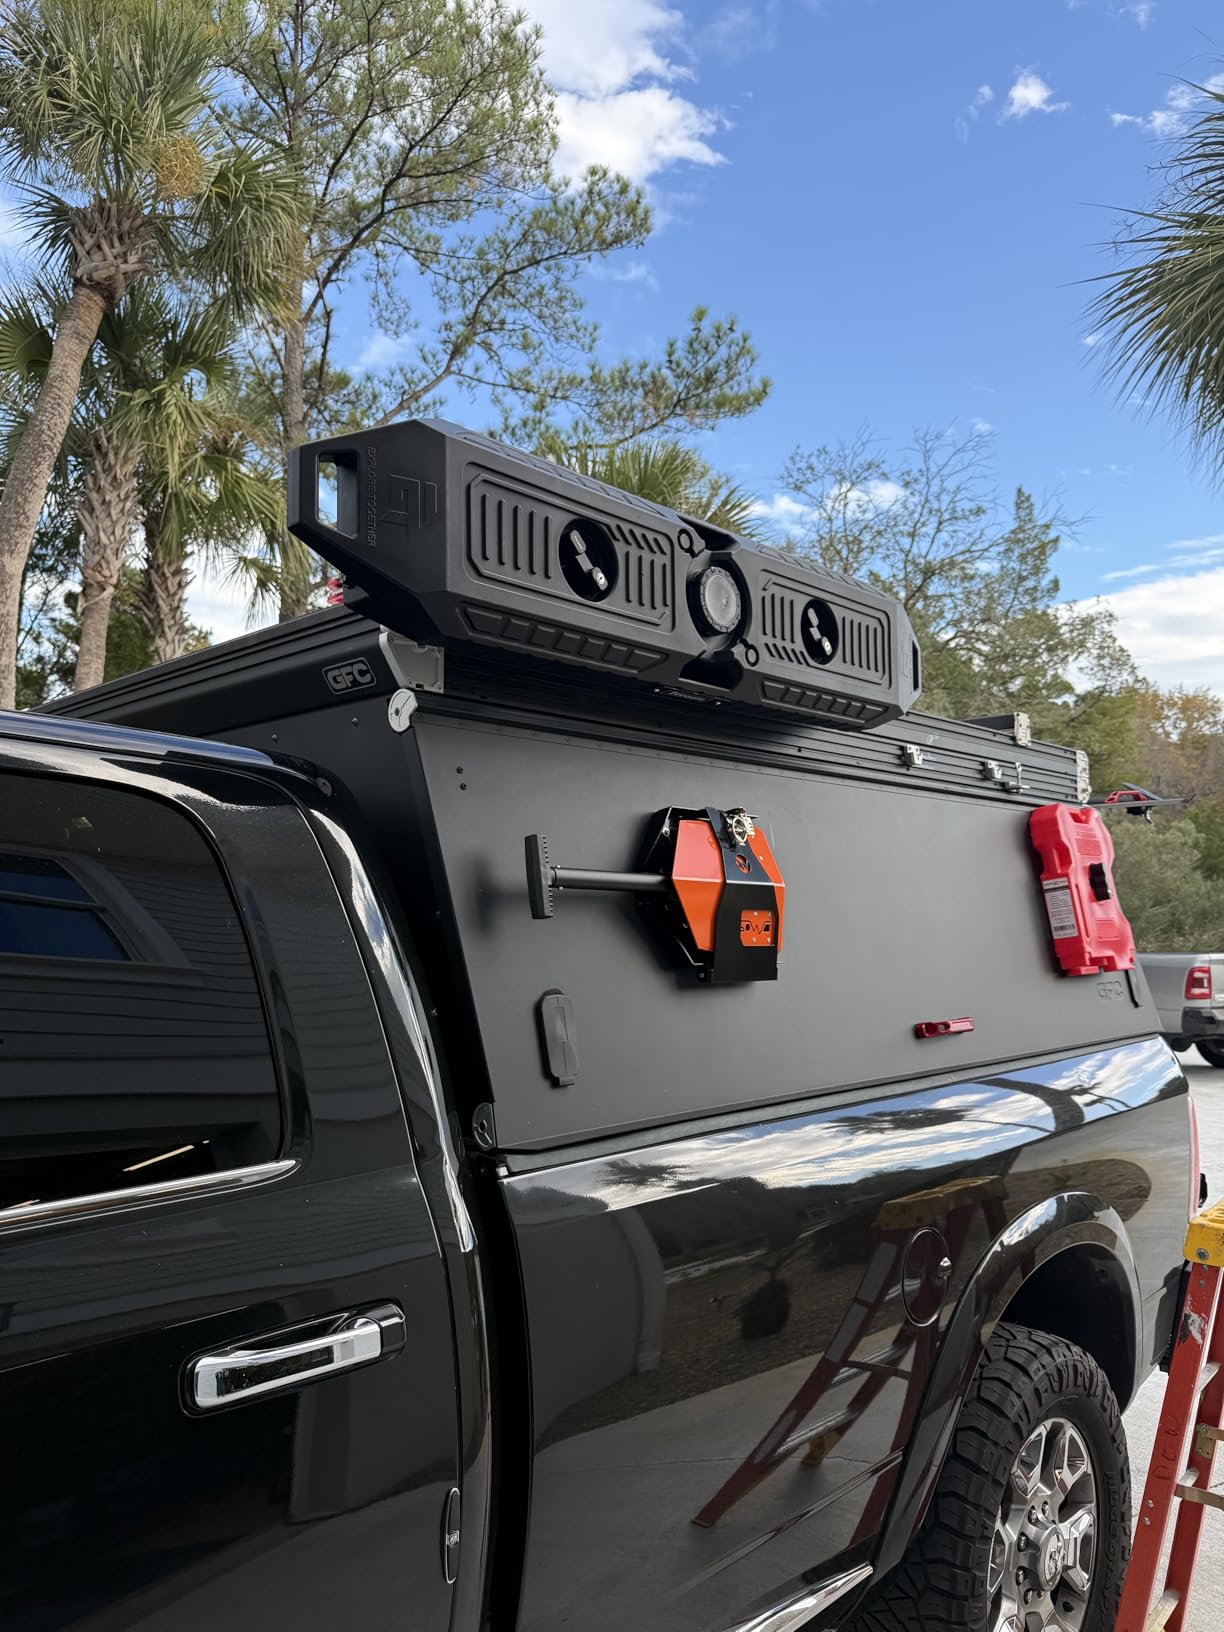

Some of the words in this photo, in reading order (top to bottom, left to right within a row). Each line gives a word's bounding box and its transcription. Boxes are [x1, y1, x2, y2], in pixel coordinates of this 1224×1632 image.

[367, 446, 376, 492] EXPLORE
[326, 662, 372, 690] GFC
[1096, 980, 1124, 1000] GFC
